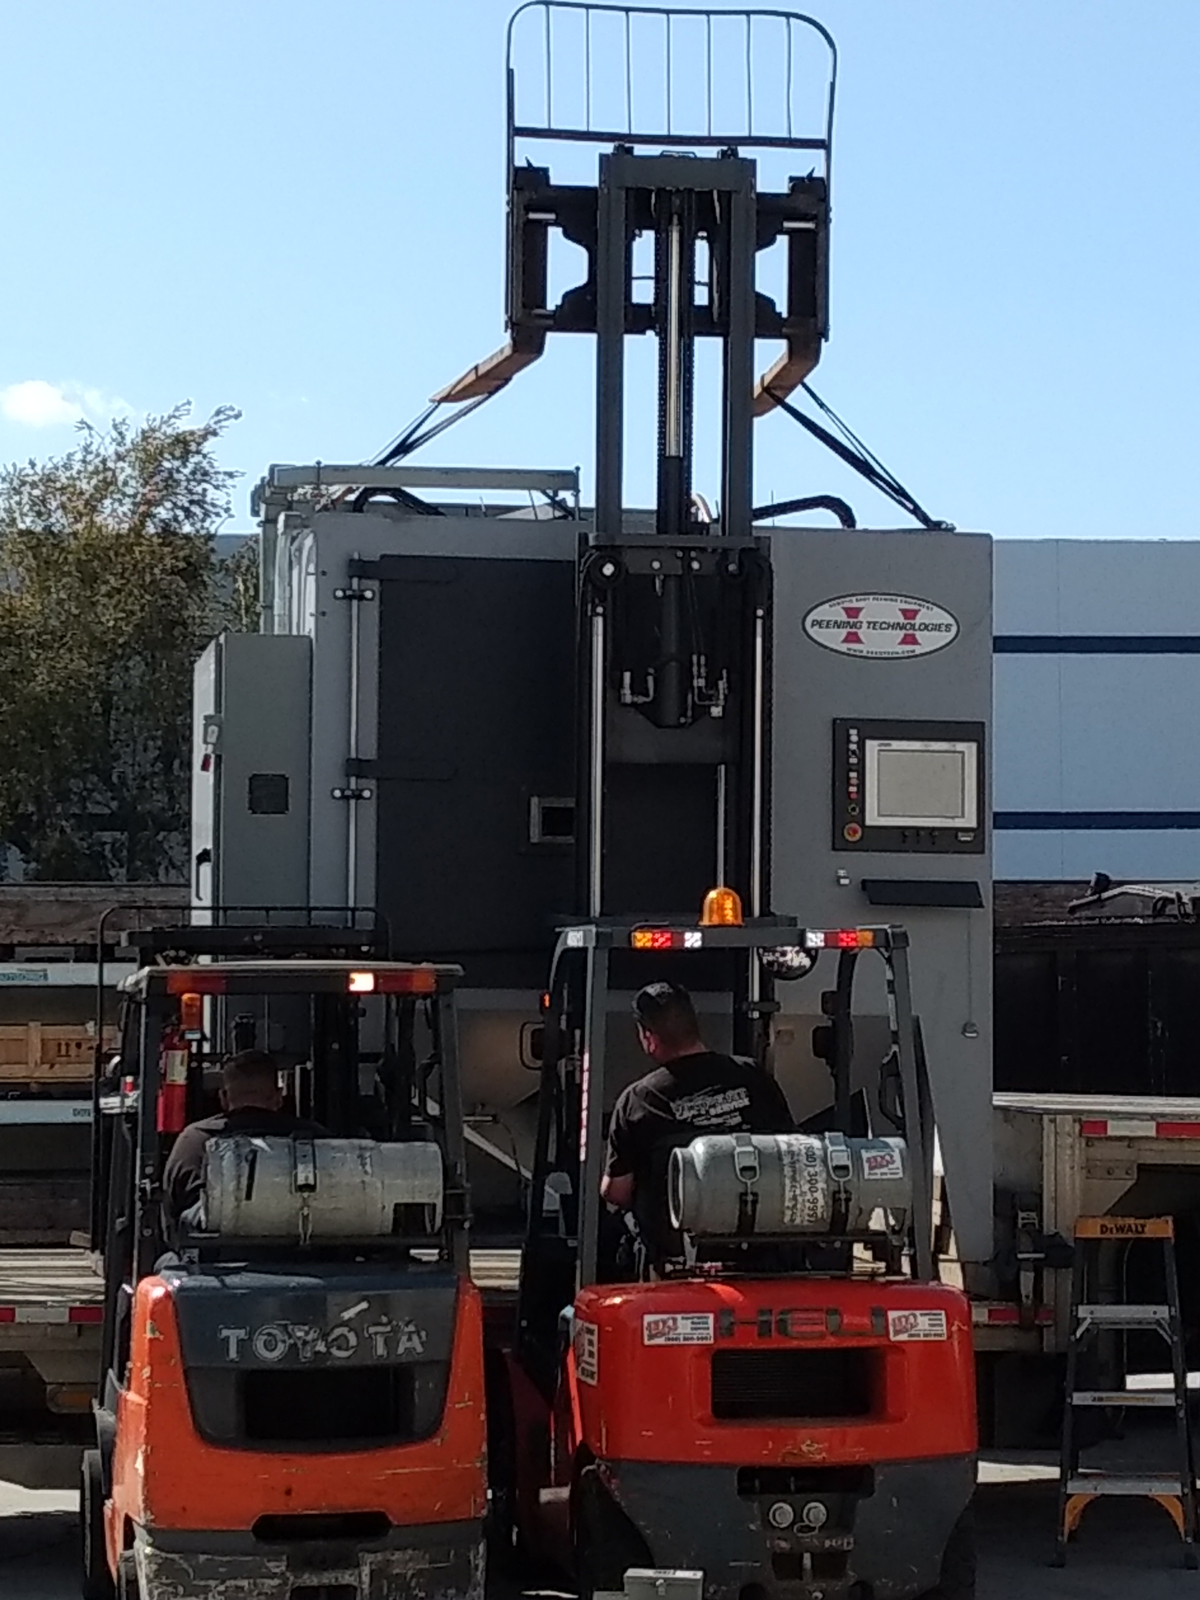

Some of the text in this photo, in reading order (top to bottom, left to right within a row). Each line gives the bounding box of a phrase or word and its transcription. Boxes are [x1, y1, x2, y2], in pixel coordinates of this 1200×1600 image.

[810, 619, 953, 633] PEENING TECHNOLOGIES
[218, 1320, 428, 1362] TOYOTA
